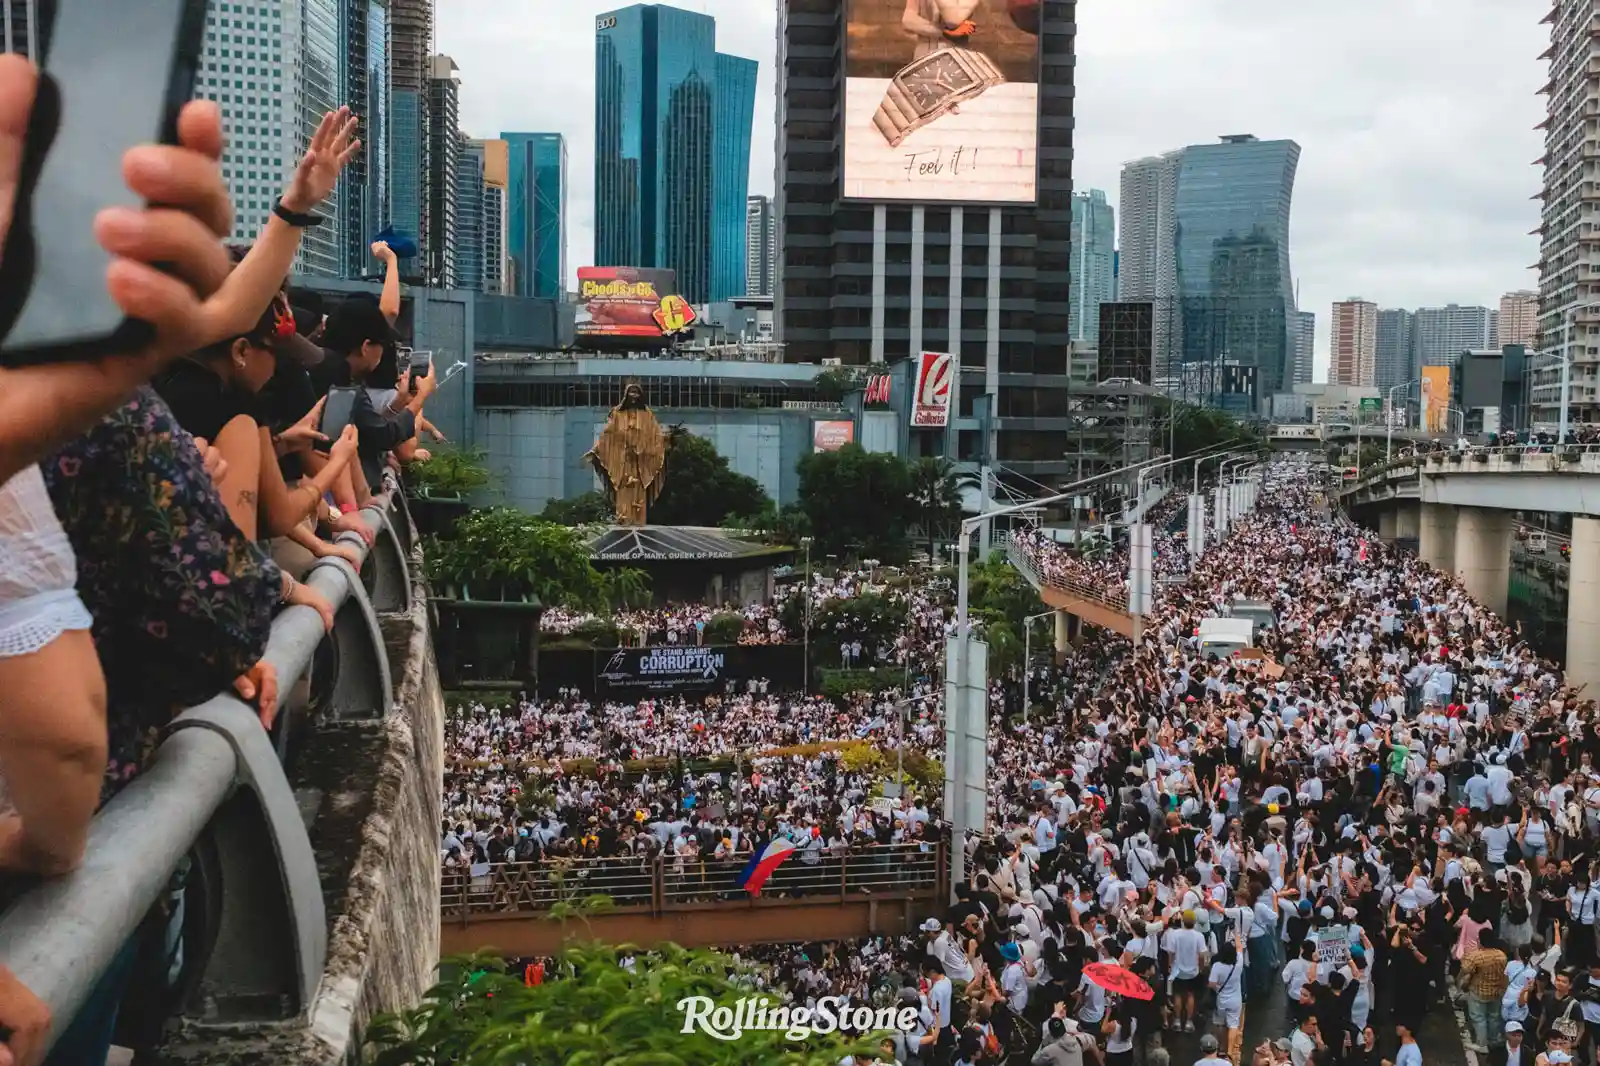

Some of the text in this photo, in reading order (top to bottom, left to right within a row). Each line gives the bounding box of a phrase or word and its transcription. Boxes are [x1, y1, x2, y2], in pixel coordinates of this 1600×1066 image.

[597, 16, 616, 30] BDO
[904, 147, 943, 182] Feel
[662, 648, 683, 656] STAND
[684, 647, 712, 655] AGAINST
[639, 653, 724, 670] CORRUPTION
